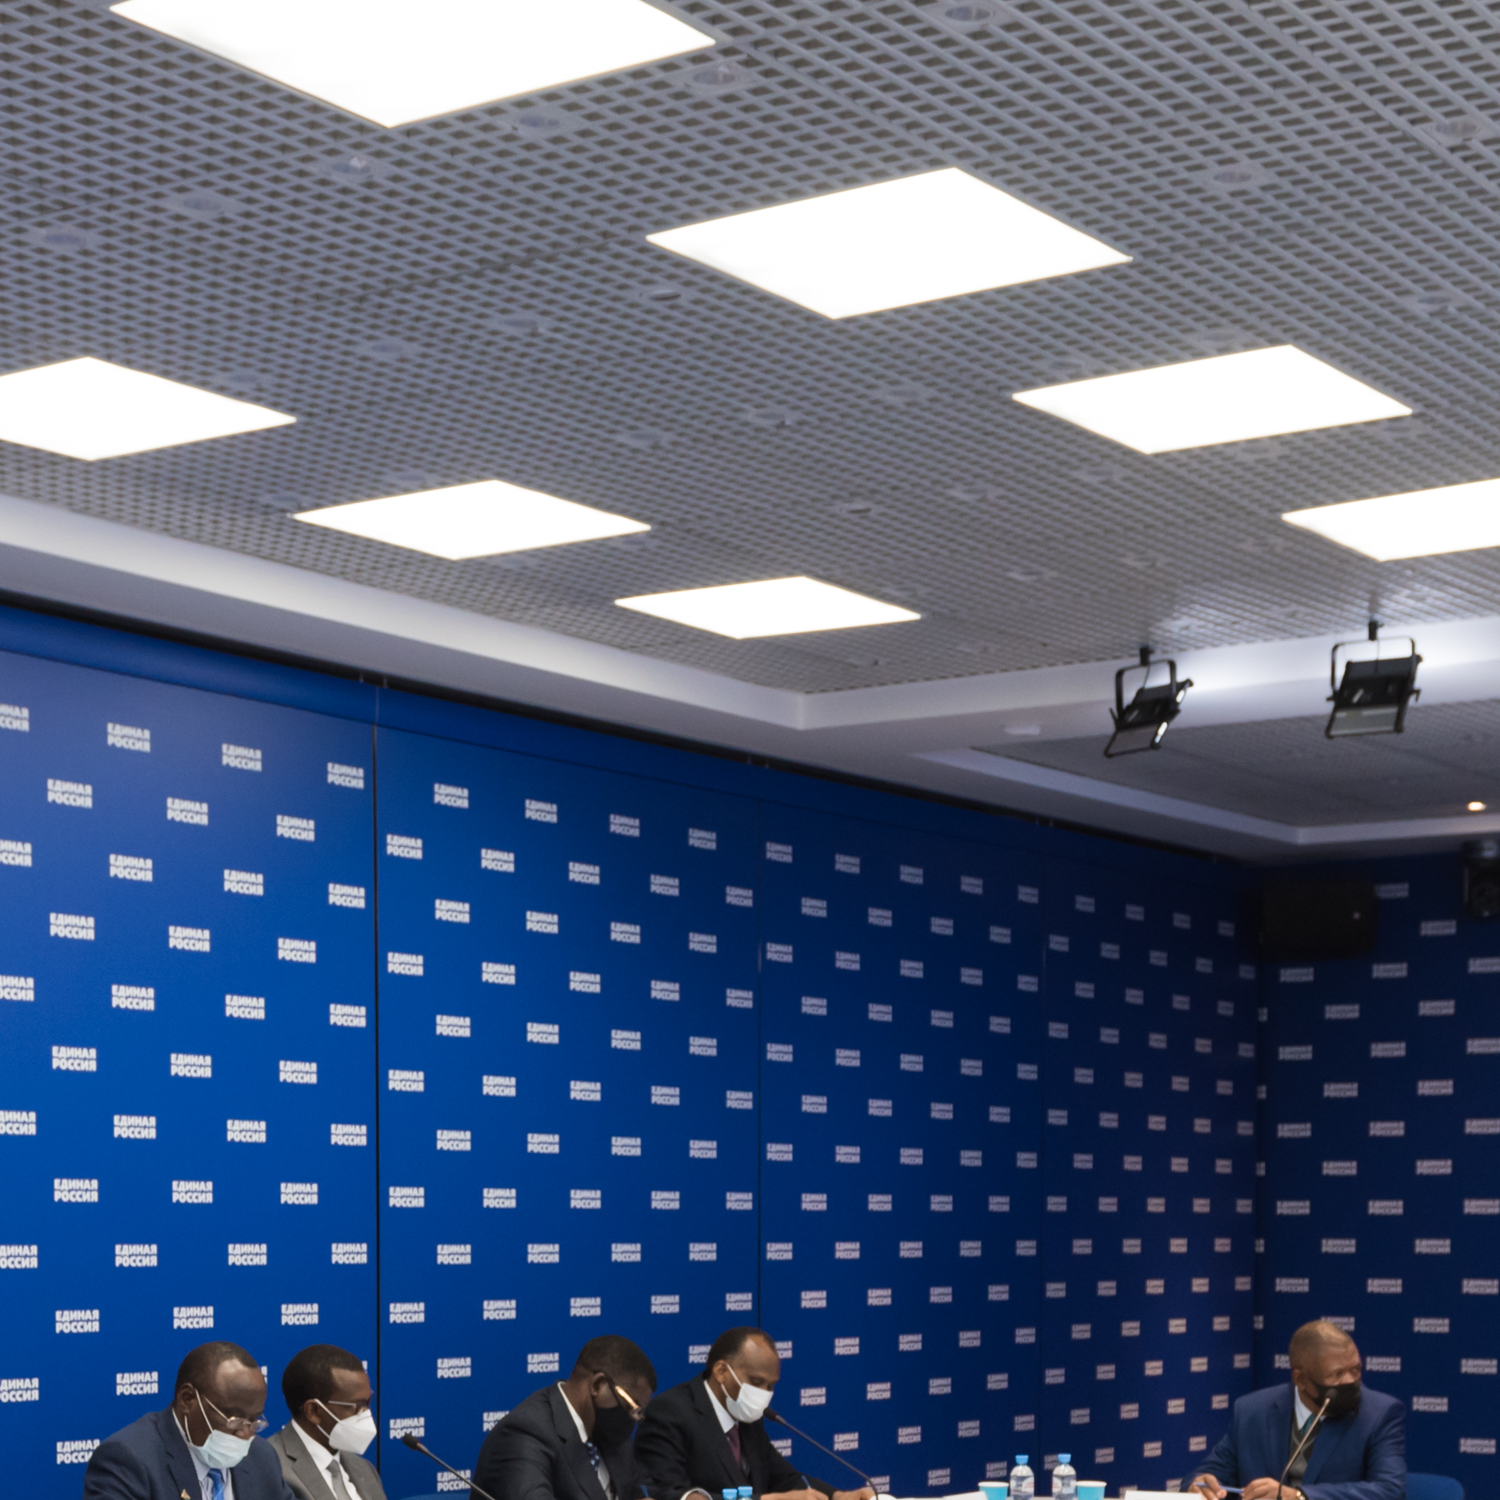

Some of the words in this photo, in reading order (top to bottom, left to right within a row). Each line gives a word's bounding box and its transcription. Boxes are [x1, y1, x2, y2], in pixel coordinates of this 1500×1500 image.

[52, 1046, 96, 1060] ЕДИНАЯ
[52, 1057, 96, 1071] РОССИЯ
[115, 1244, 157, 1255] ЕДИНАЯ
[115, 1255, 157, 1267] РОССИЯ
[56, 1310, 99, 1322] ЕДИНАЯ
[56, 1320, 99, 1333] РОССИЯ
